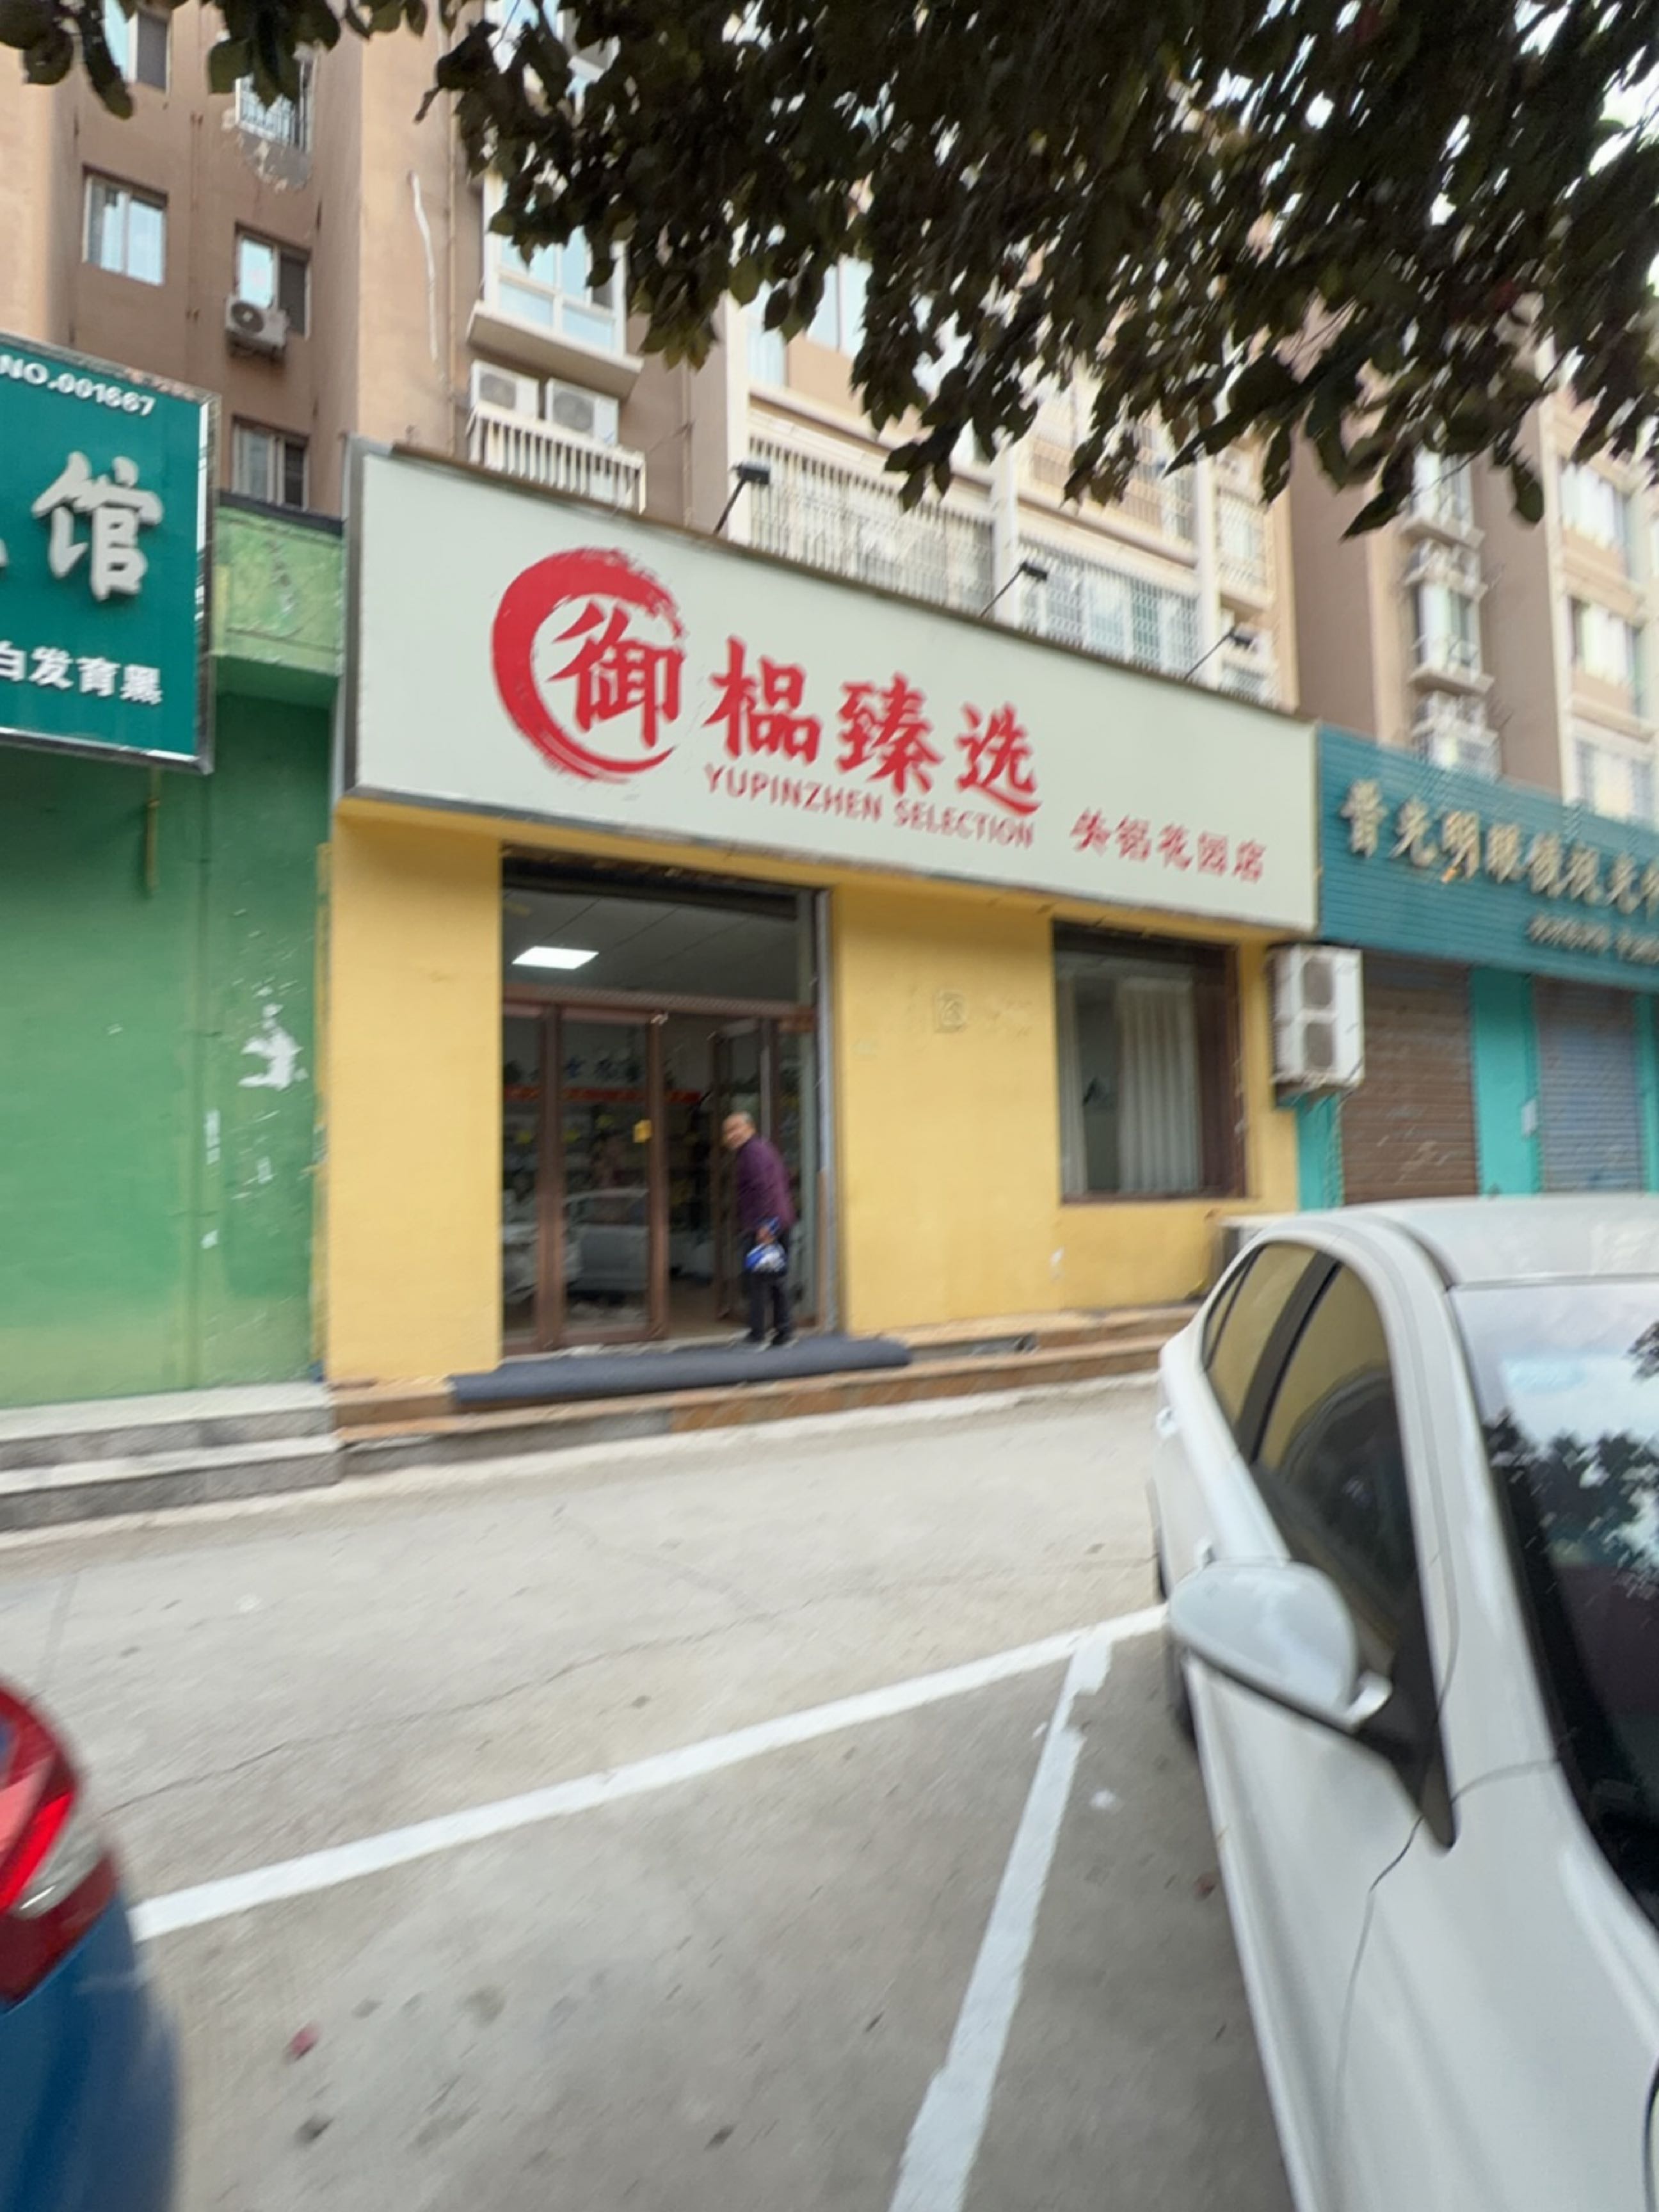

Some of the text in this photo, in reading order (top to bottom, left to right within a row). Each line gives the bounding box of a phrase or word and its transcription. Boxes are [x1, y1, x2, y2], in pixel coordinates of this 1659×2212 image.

[0, 451, 163, 602] 馆
[0, 640, 163, 705] 白发育黑
[704, 762, 1034, 849] YUPINZHEN SELECTION
